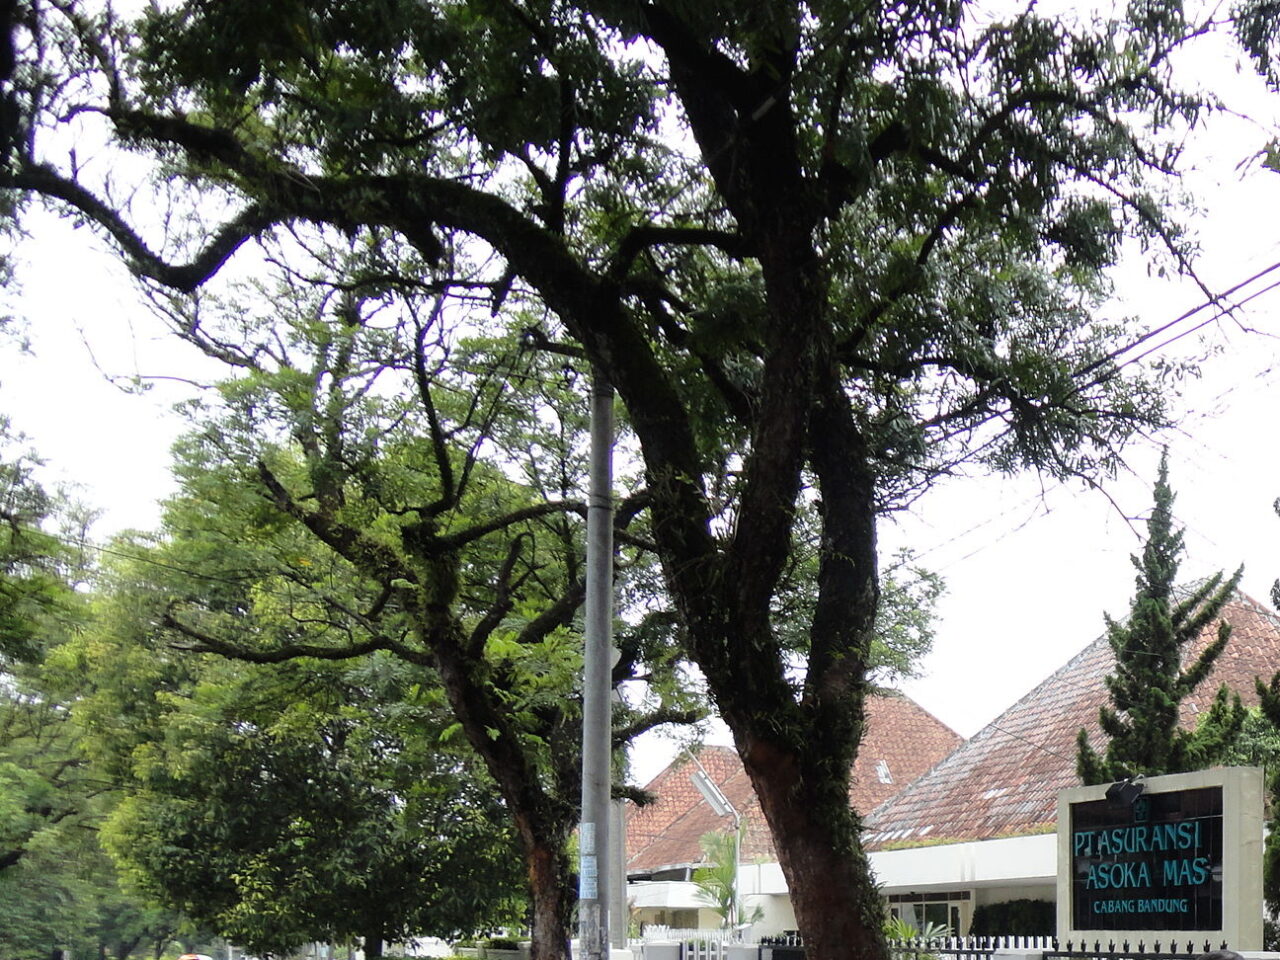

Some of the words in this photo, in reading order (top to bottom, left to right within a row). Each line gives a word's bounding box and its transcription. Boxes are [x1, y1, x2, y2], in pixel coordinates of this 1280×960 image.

[1100, 822, 1201, 855] ASURANSI
[1086, 862, 1151, 890] ASOKA
[1163, 857, 1210, 886] MAS
[1093, 900, 1135, 914] CABANG
[1137, 899, 1188, 913] BANDUNG
